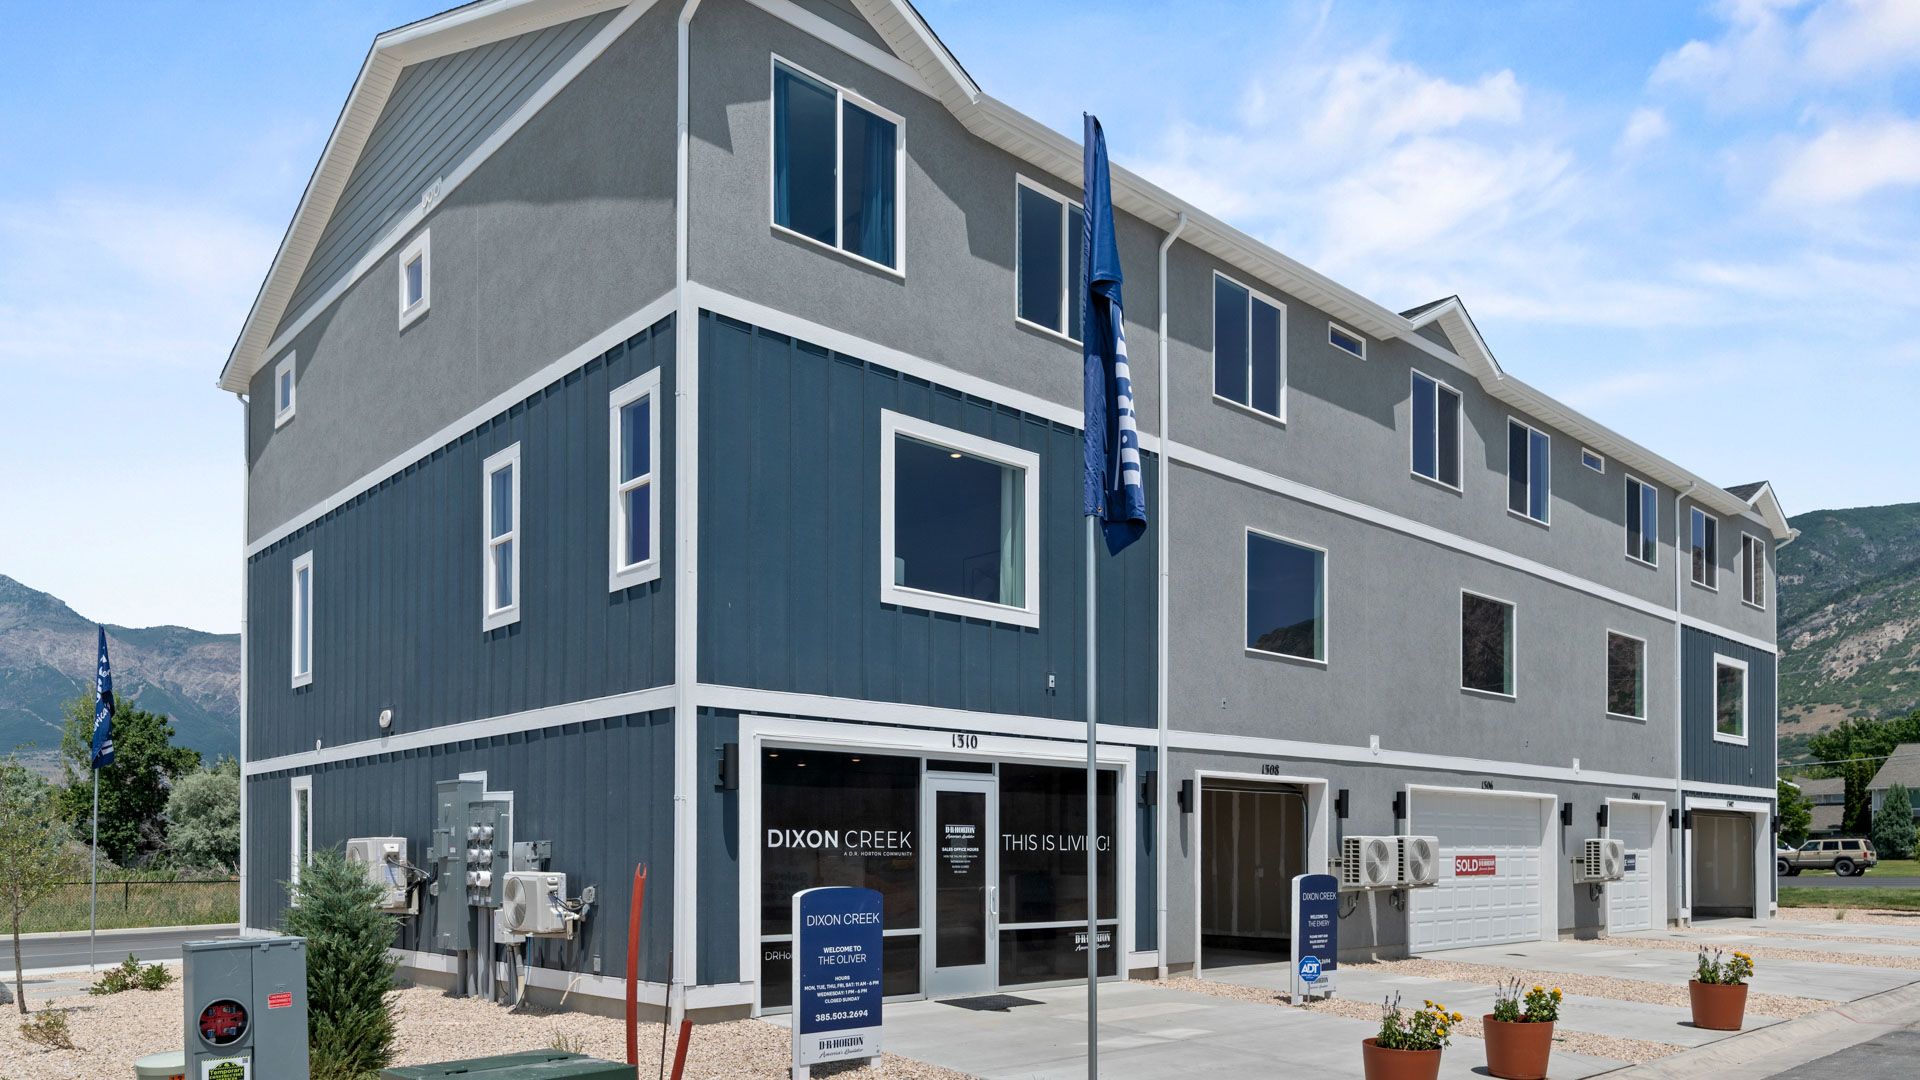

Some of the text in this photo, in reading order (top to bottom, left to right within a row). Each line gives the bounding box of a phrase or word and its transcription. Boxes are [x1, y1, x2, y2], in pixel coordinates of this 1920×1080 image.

[952, 734, 978, 749] 1310
[767, 829, 912, 849] DIXON CREEK
[1002, 834, 1110, 851] THIS IS LIVIG!
[1456, 859, 1478, 871] SOLD
[1302, 891, 1337, 901] DIXON CREEK
[806, 912, 880, 926] DIXON CREEK
[818, 954, 867, 965] THE OLIVER
[1301, 963, 1320, 973] ADT
[815, 1010, 868, 1022] 385.503.2694
[209, 1067, 244, 1076] Temporary
